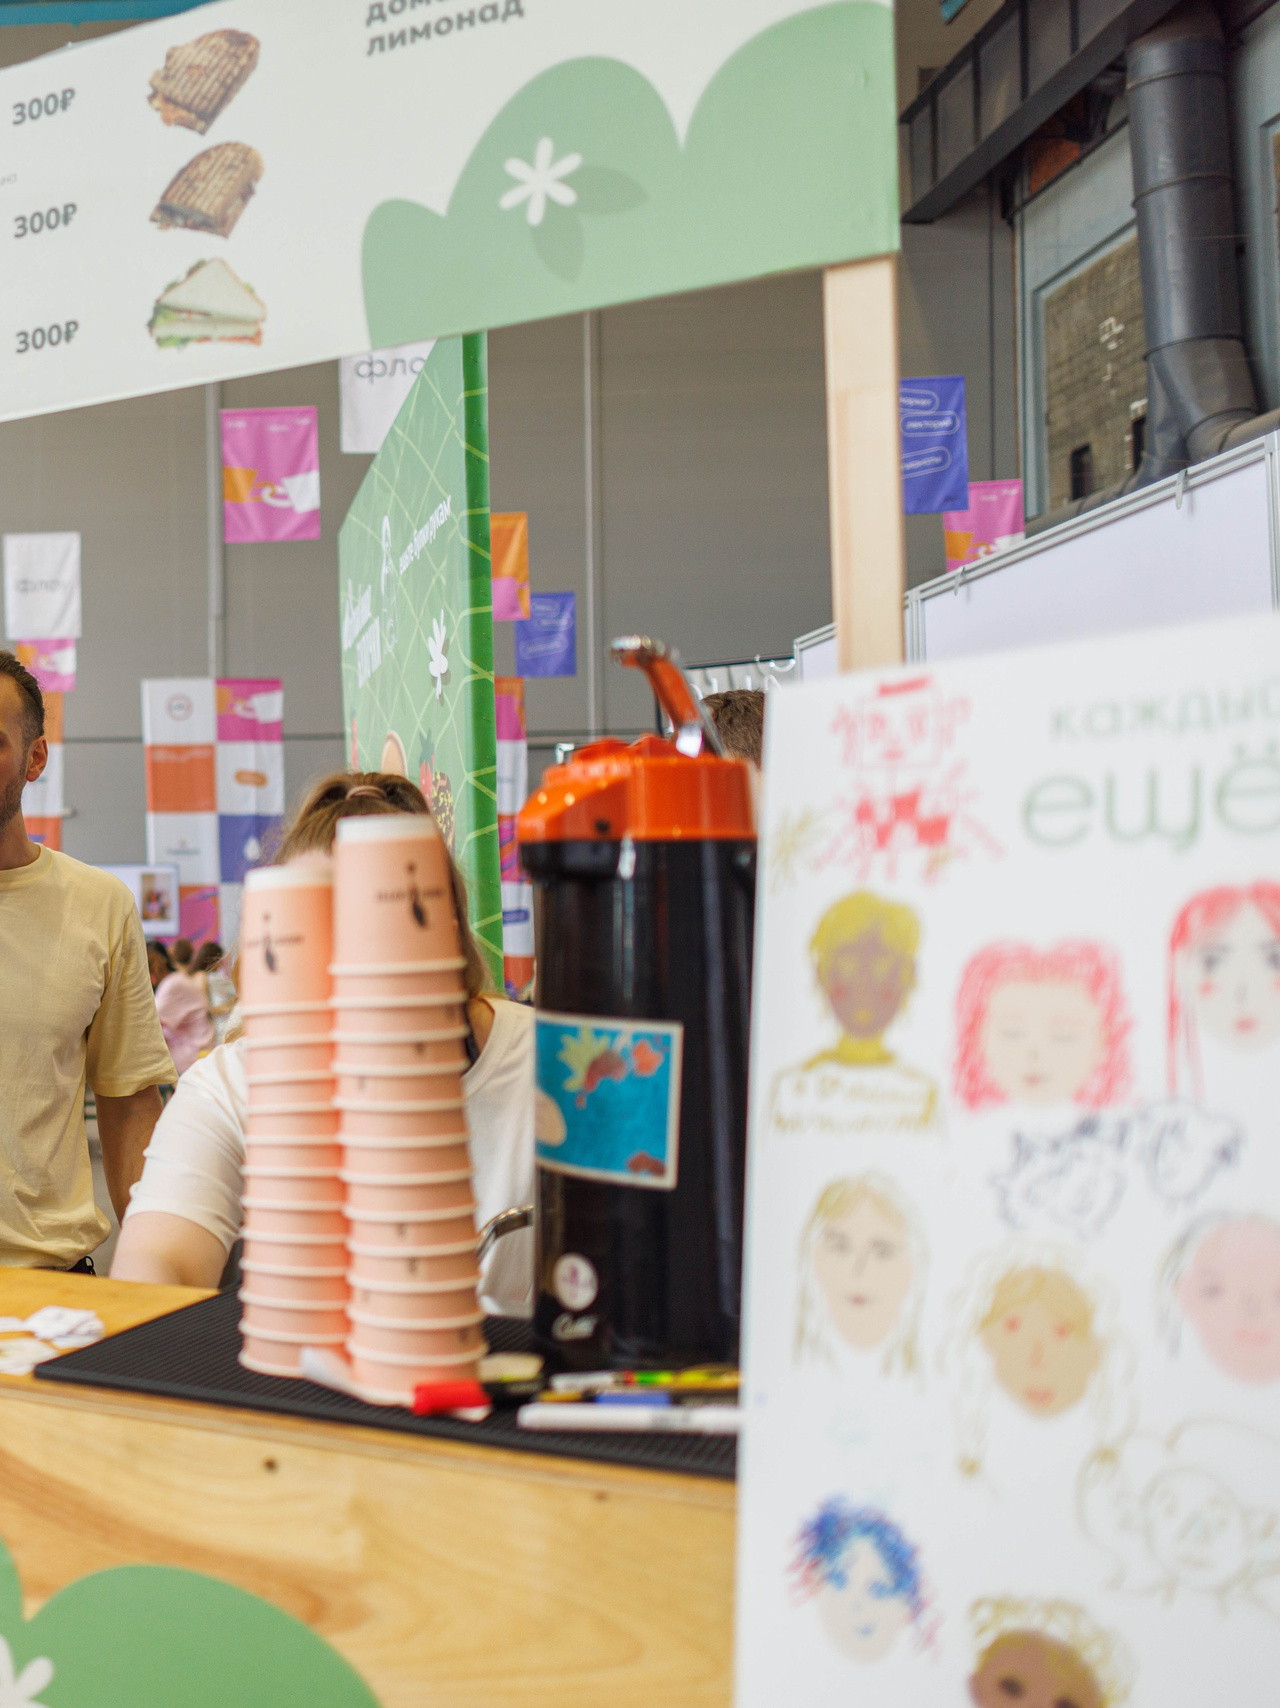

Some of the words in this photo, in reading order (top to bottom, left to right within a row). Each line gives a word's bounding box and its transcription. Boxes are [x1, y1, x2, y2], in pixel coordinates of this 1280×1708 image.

[366, 0, 525, 56] лимонад
[12, 88, 76, 126] 300₽
[13, 203, 78, 239] 300₽
[14, 319, 80, 355] 300₽
[1020, 741, 1280, 855] ещё
